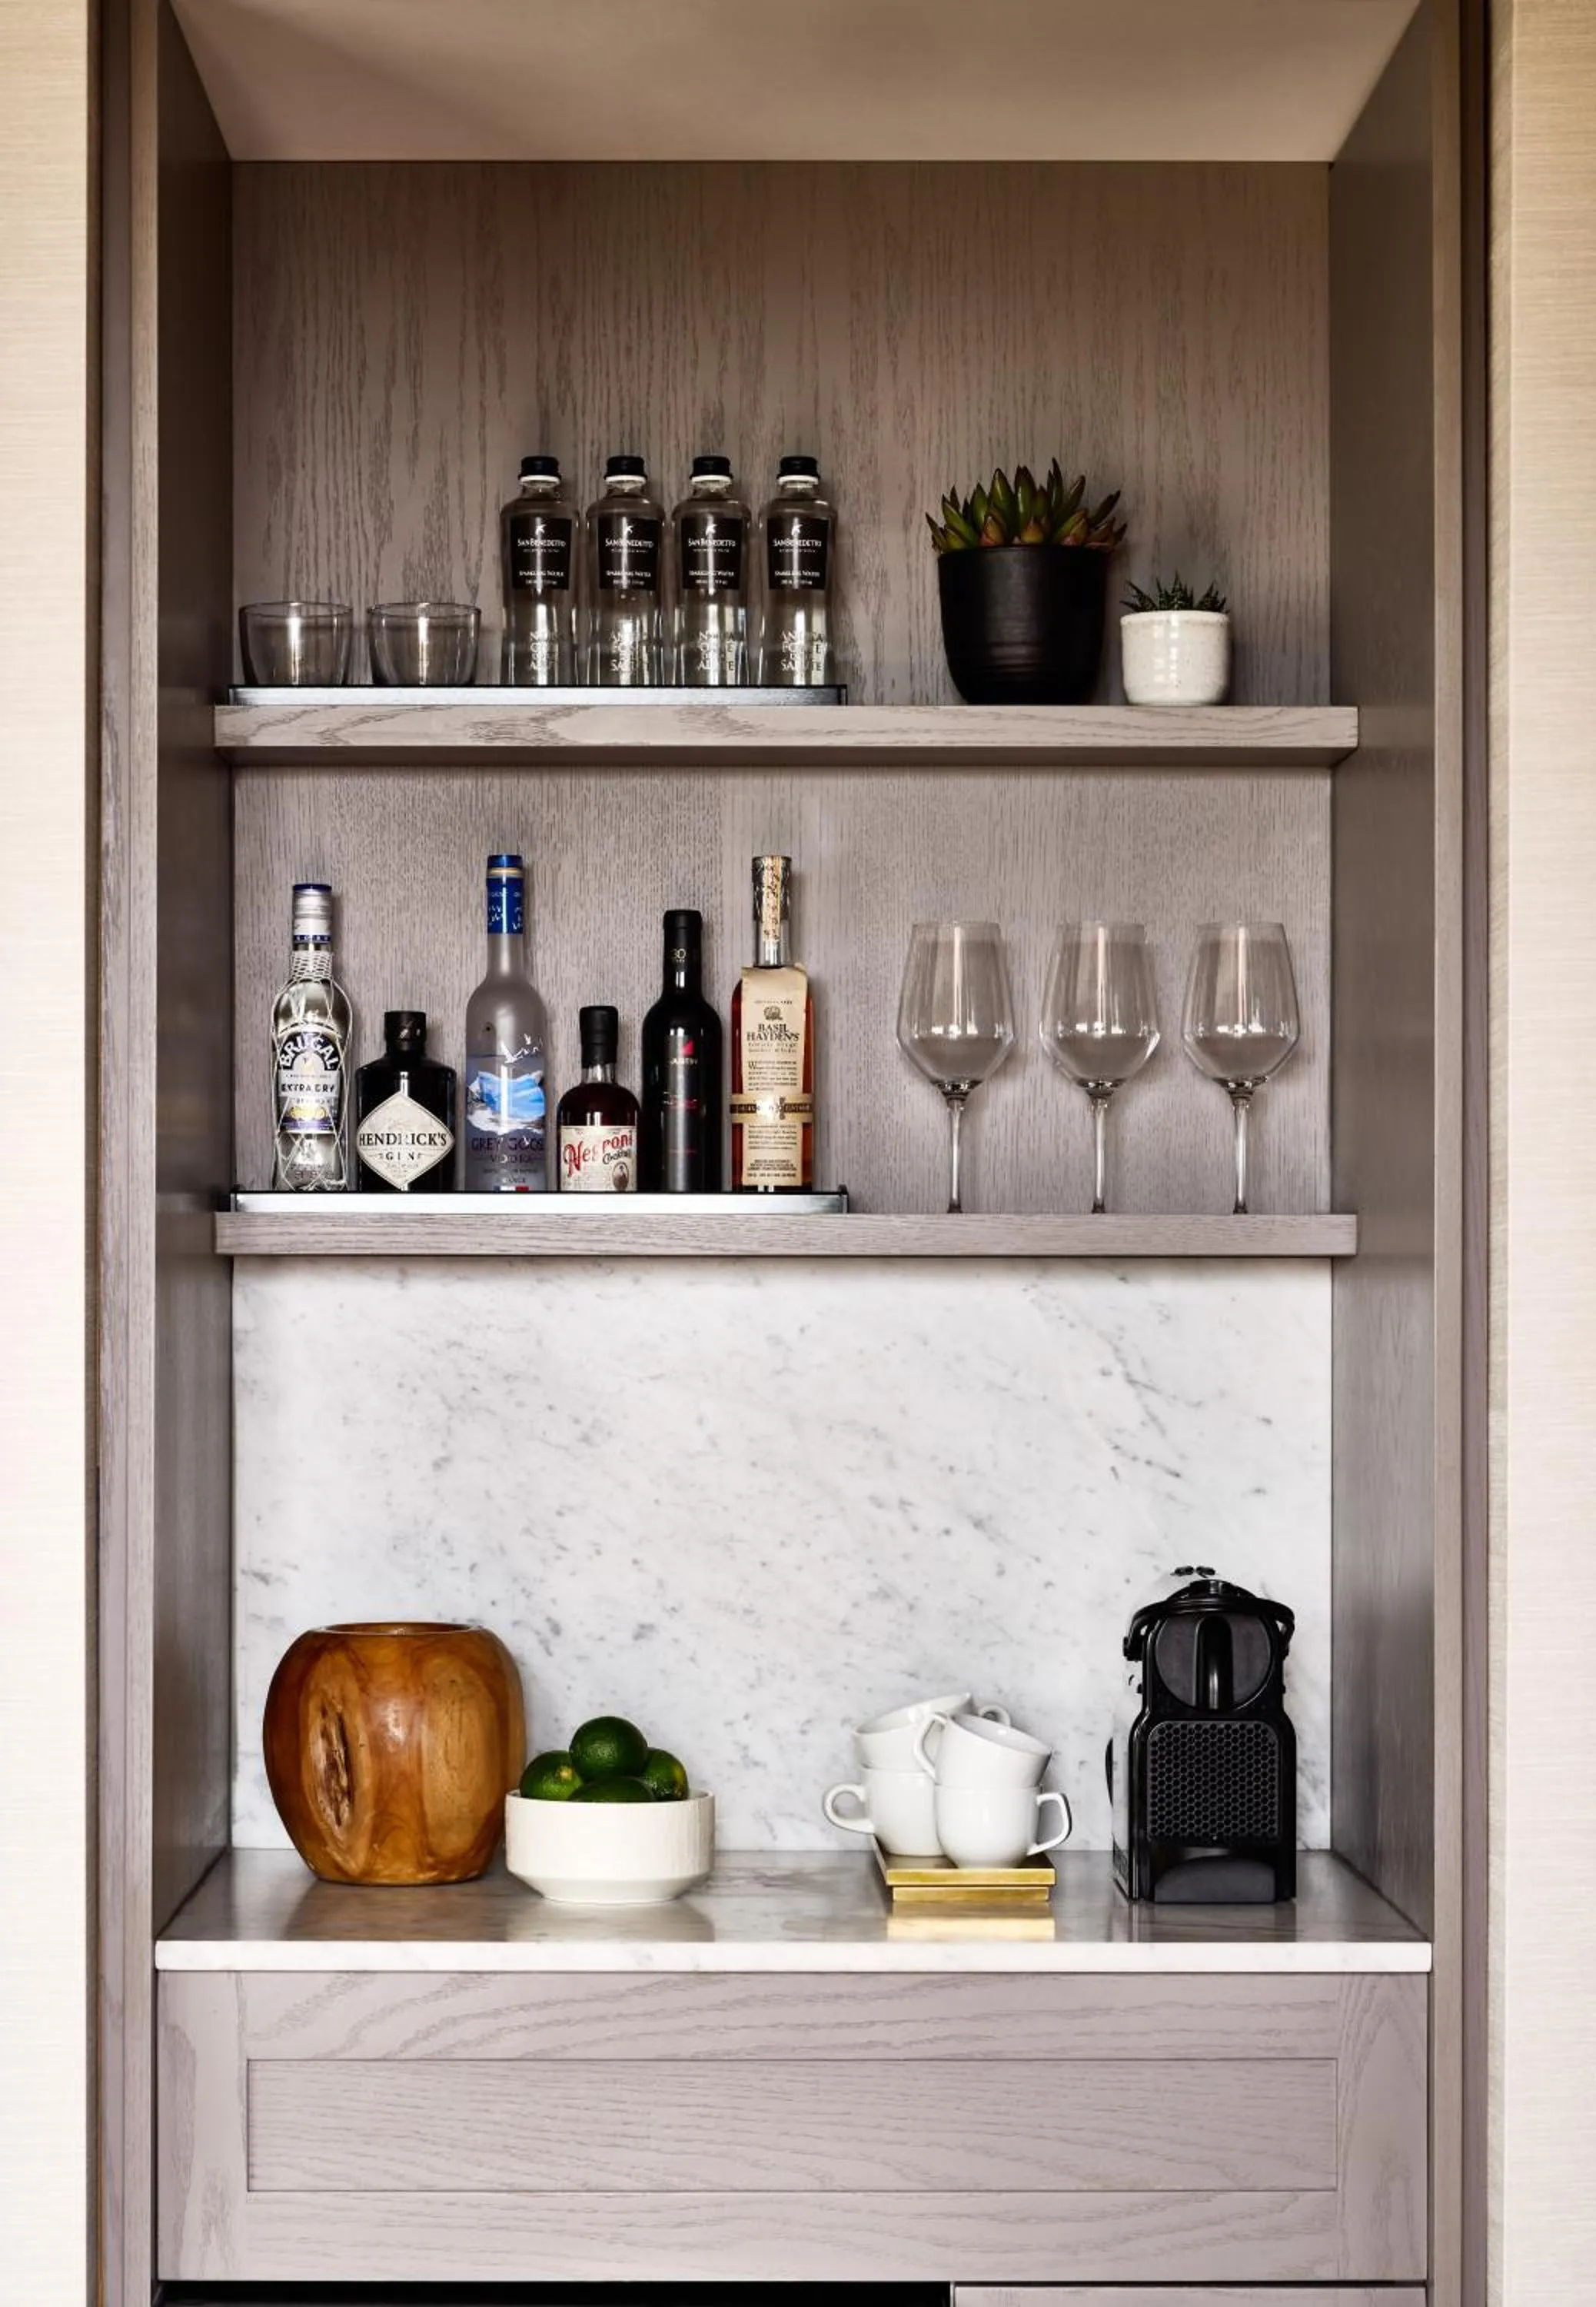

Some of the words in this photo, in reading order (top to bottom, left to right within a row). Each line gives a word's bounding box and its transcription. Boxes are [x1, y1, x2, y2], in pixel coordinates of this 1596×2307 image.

[757, 1024, 789, 1032] BASIL
[281, 1084, 311, 1093] EXTRA
[314, 1084, 335, 1093] DRY
[359, 1133, 447, 1147] HENDRICK'S
[471, 1137, 500, 1152] GREY
[508, 1137, 545, 1151] GOOS
[385, 1151, 415, 1160] GIN
